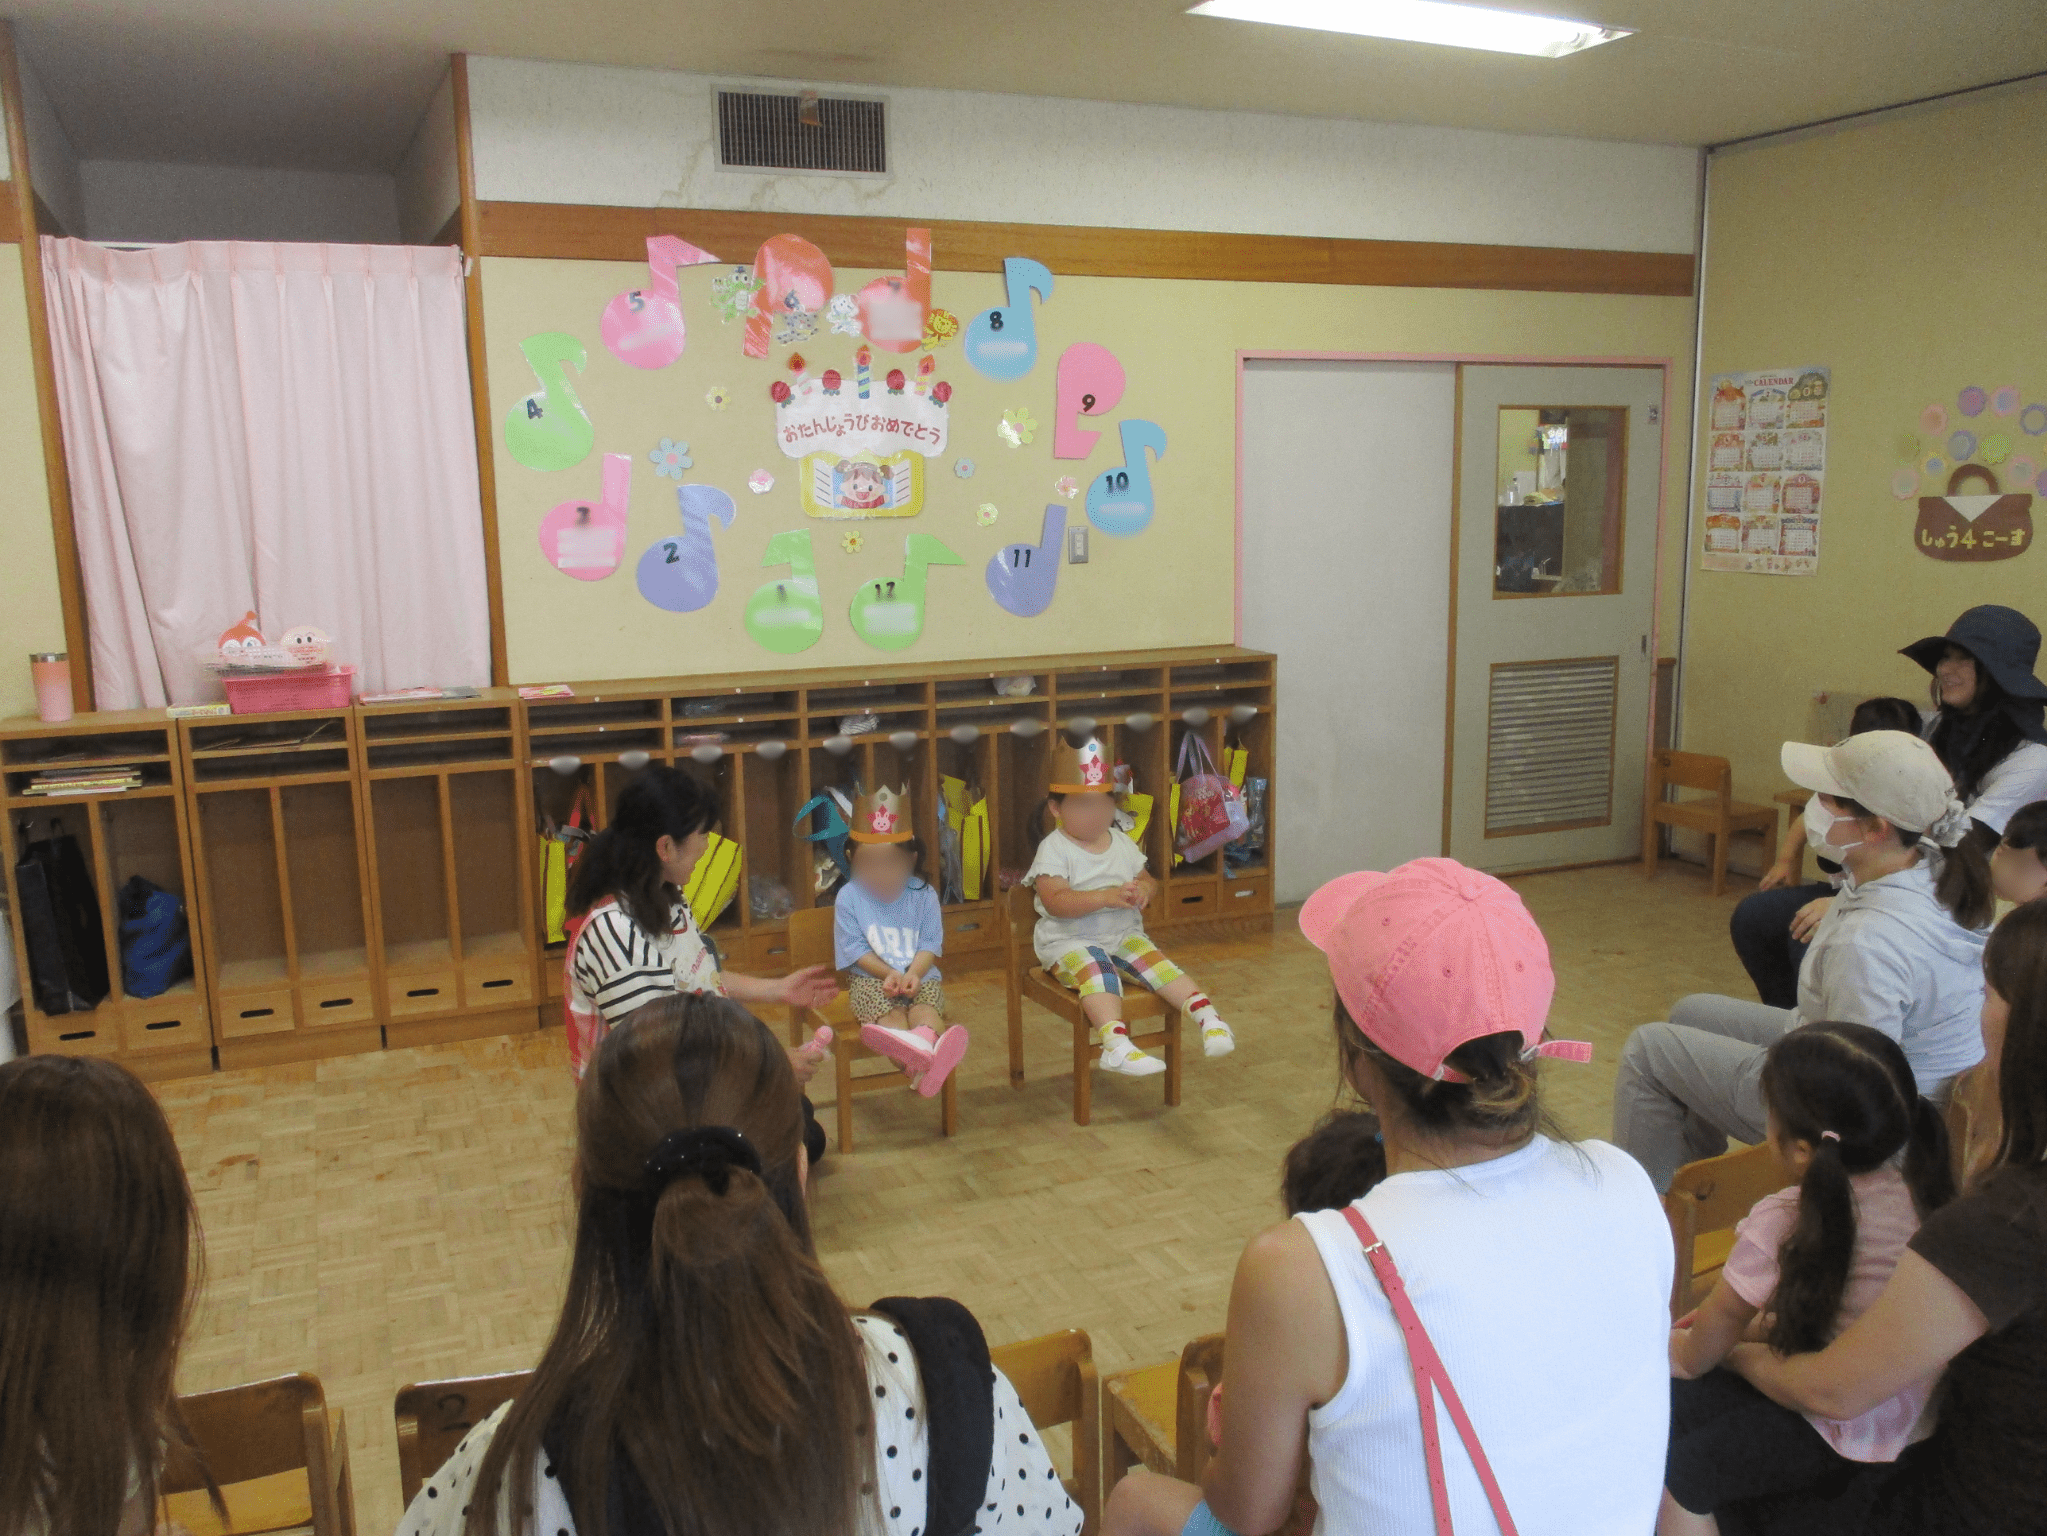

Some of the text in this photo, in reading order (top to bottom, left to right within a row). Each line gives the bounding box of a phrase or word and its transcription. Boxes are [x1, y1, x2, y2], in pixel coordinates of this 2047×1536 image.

[629, 290, 645, 312] 5
[989, 311, 1004, 332] 8
[1754, 377, 1794, 387] CALENDAR
[526, 398, 543, 420] 4
[1082, 394, 1095, 413] 9
[783, 413, 941, 445] おたんじょうびおめでとう
[1106, 472, 1129, 493] 10
[663, 542, 680, 564] 2
[1014, 549, 1031, 568] 11
